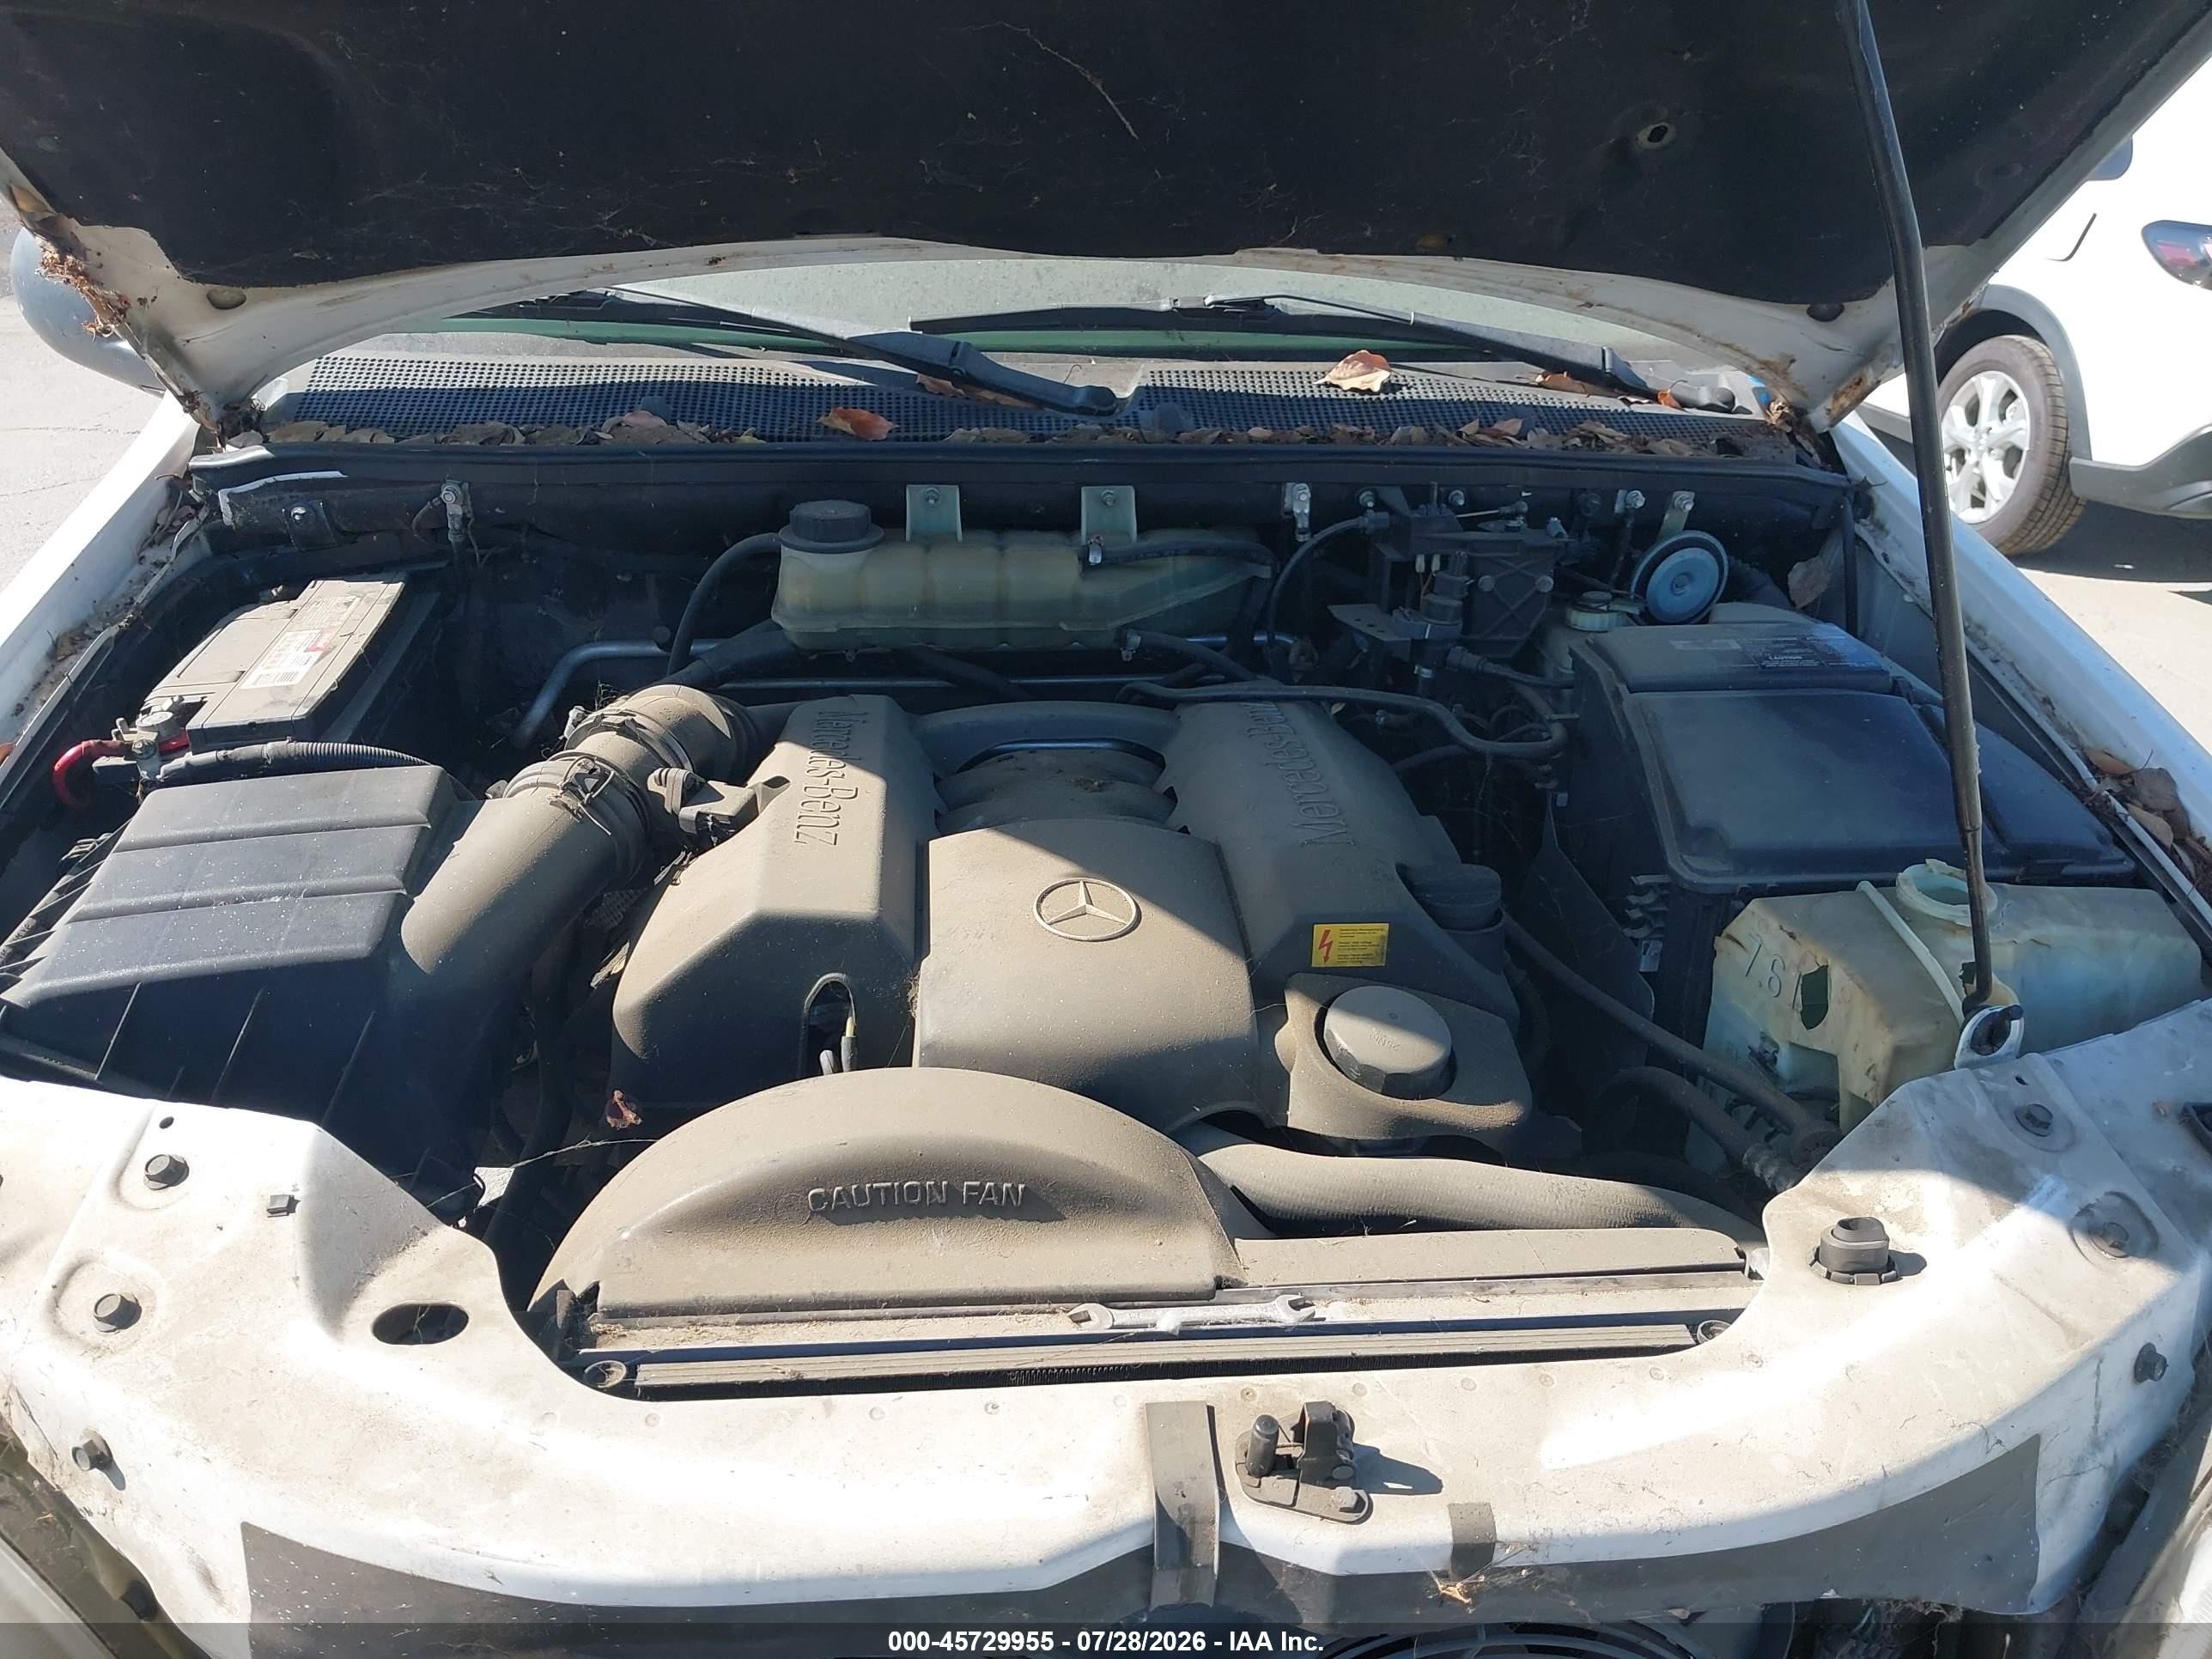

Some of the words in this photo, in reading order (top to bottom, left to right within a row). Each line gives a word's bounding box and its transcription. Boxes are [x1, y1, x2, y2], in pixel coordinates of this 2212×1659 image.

[794, 711, 869, 846] Mercedes-Benz
[1243, 702, 1354, 848] Mercedes-Benz
[808, 1181, 948, 1212] CAUTION
[963, 1181, 1025, 1206] FAN
